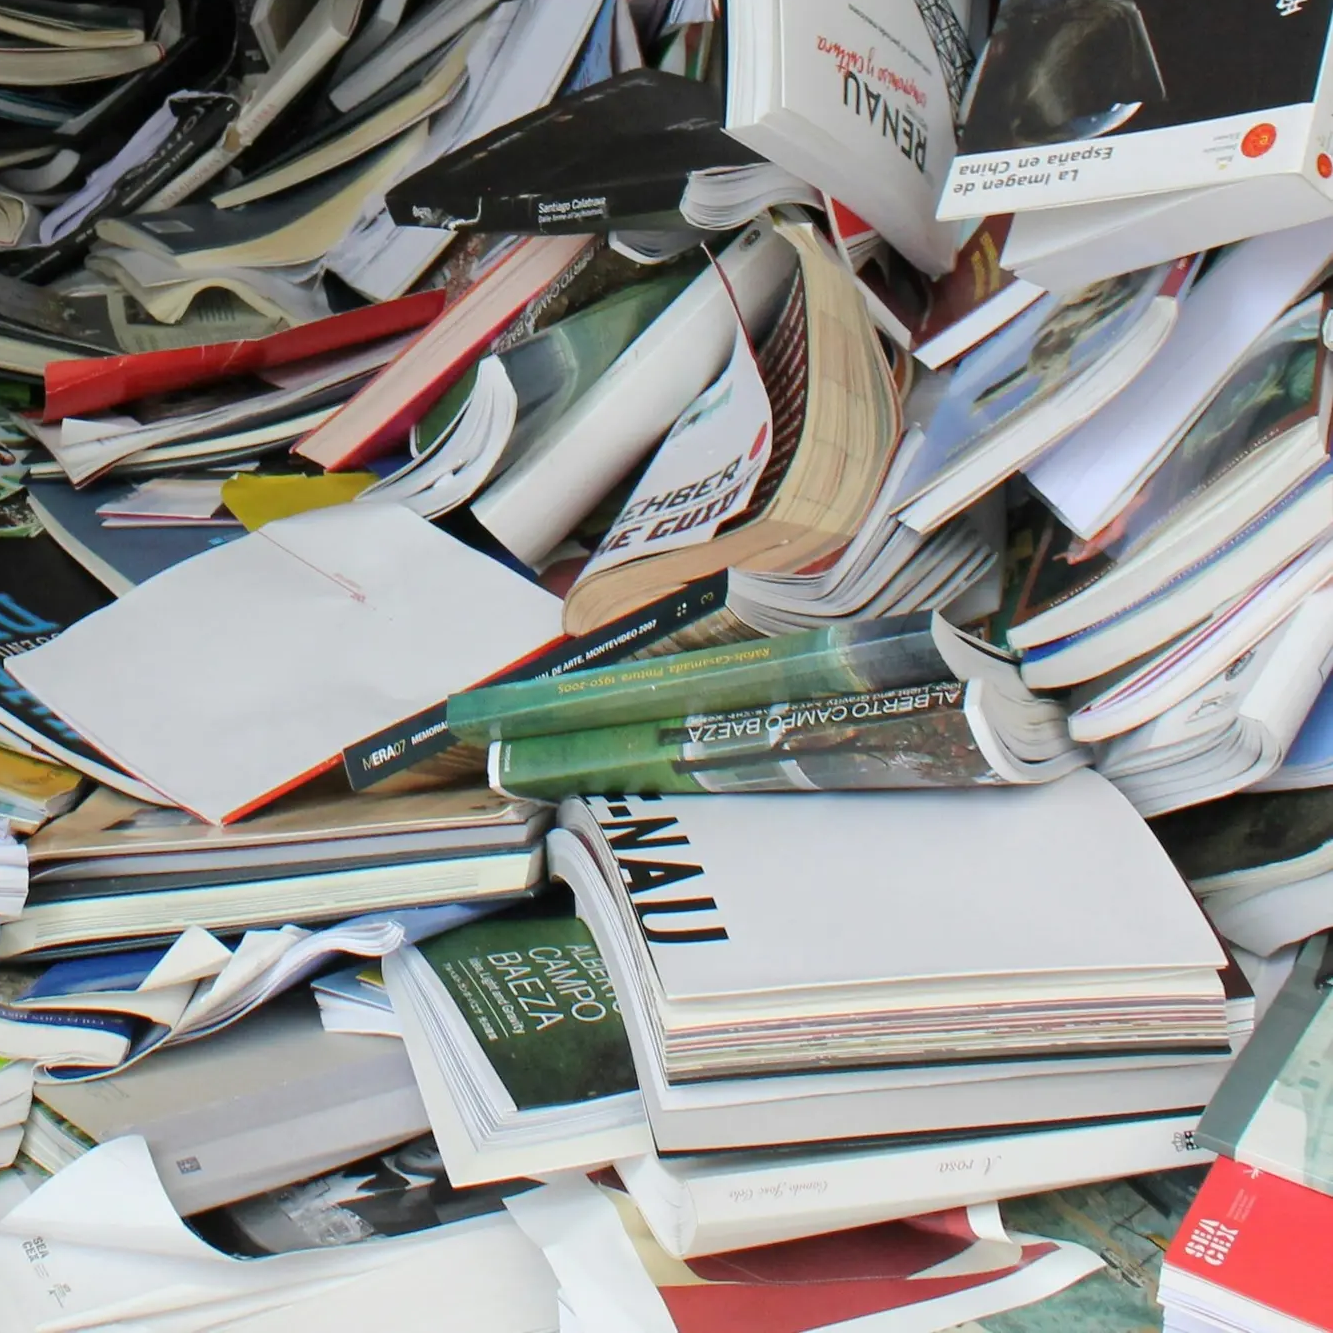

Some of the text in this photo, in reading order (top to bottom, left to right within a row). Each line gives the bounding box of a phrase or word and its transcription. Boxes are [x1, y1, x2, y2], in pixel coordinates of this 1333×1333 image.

[842, 69, 927, 174] RENAU
[958, 147, 1114, 178] España en China
[953, 168, 1079, 195] La Imagen de
[538, 197, 607, 214] Santiago Calatrava
[637, 619, 659, 635] 2007
[584, 630, 636, 662] MONTEVIDEO
[557, 673, 614, 697] 1950-2005
[687, 688, 960, 743] ALBERTO CAMPO BAEZA
[410, 719, 449, 746] MEMORIA
[361, 739, 407, 772] MERA07
[487, 950, 564, 1031] BAEZA
[527, 946, 606, 1022] CAMPO
[499, 1002, 526, 1035] Gravity
[1184, 1218, 1216, 1260] SEA
[1205, 1217, 1241, 1268] CEX
